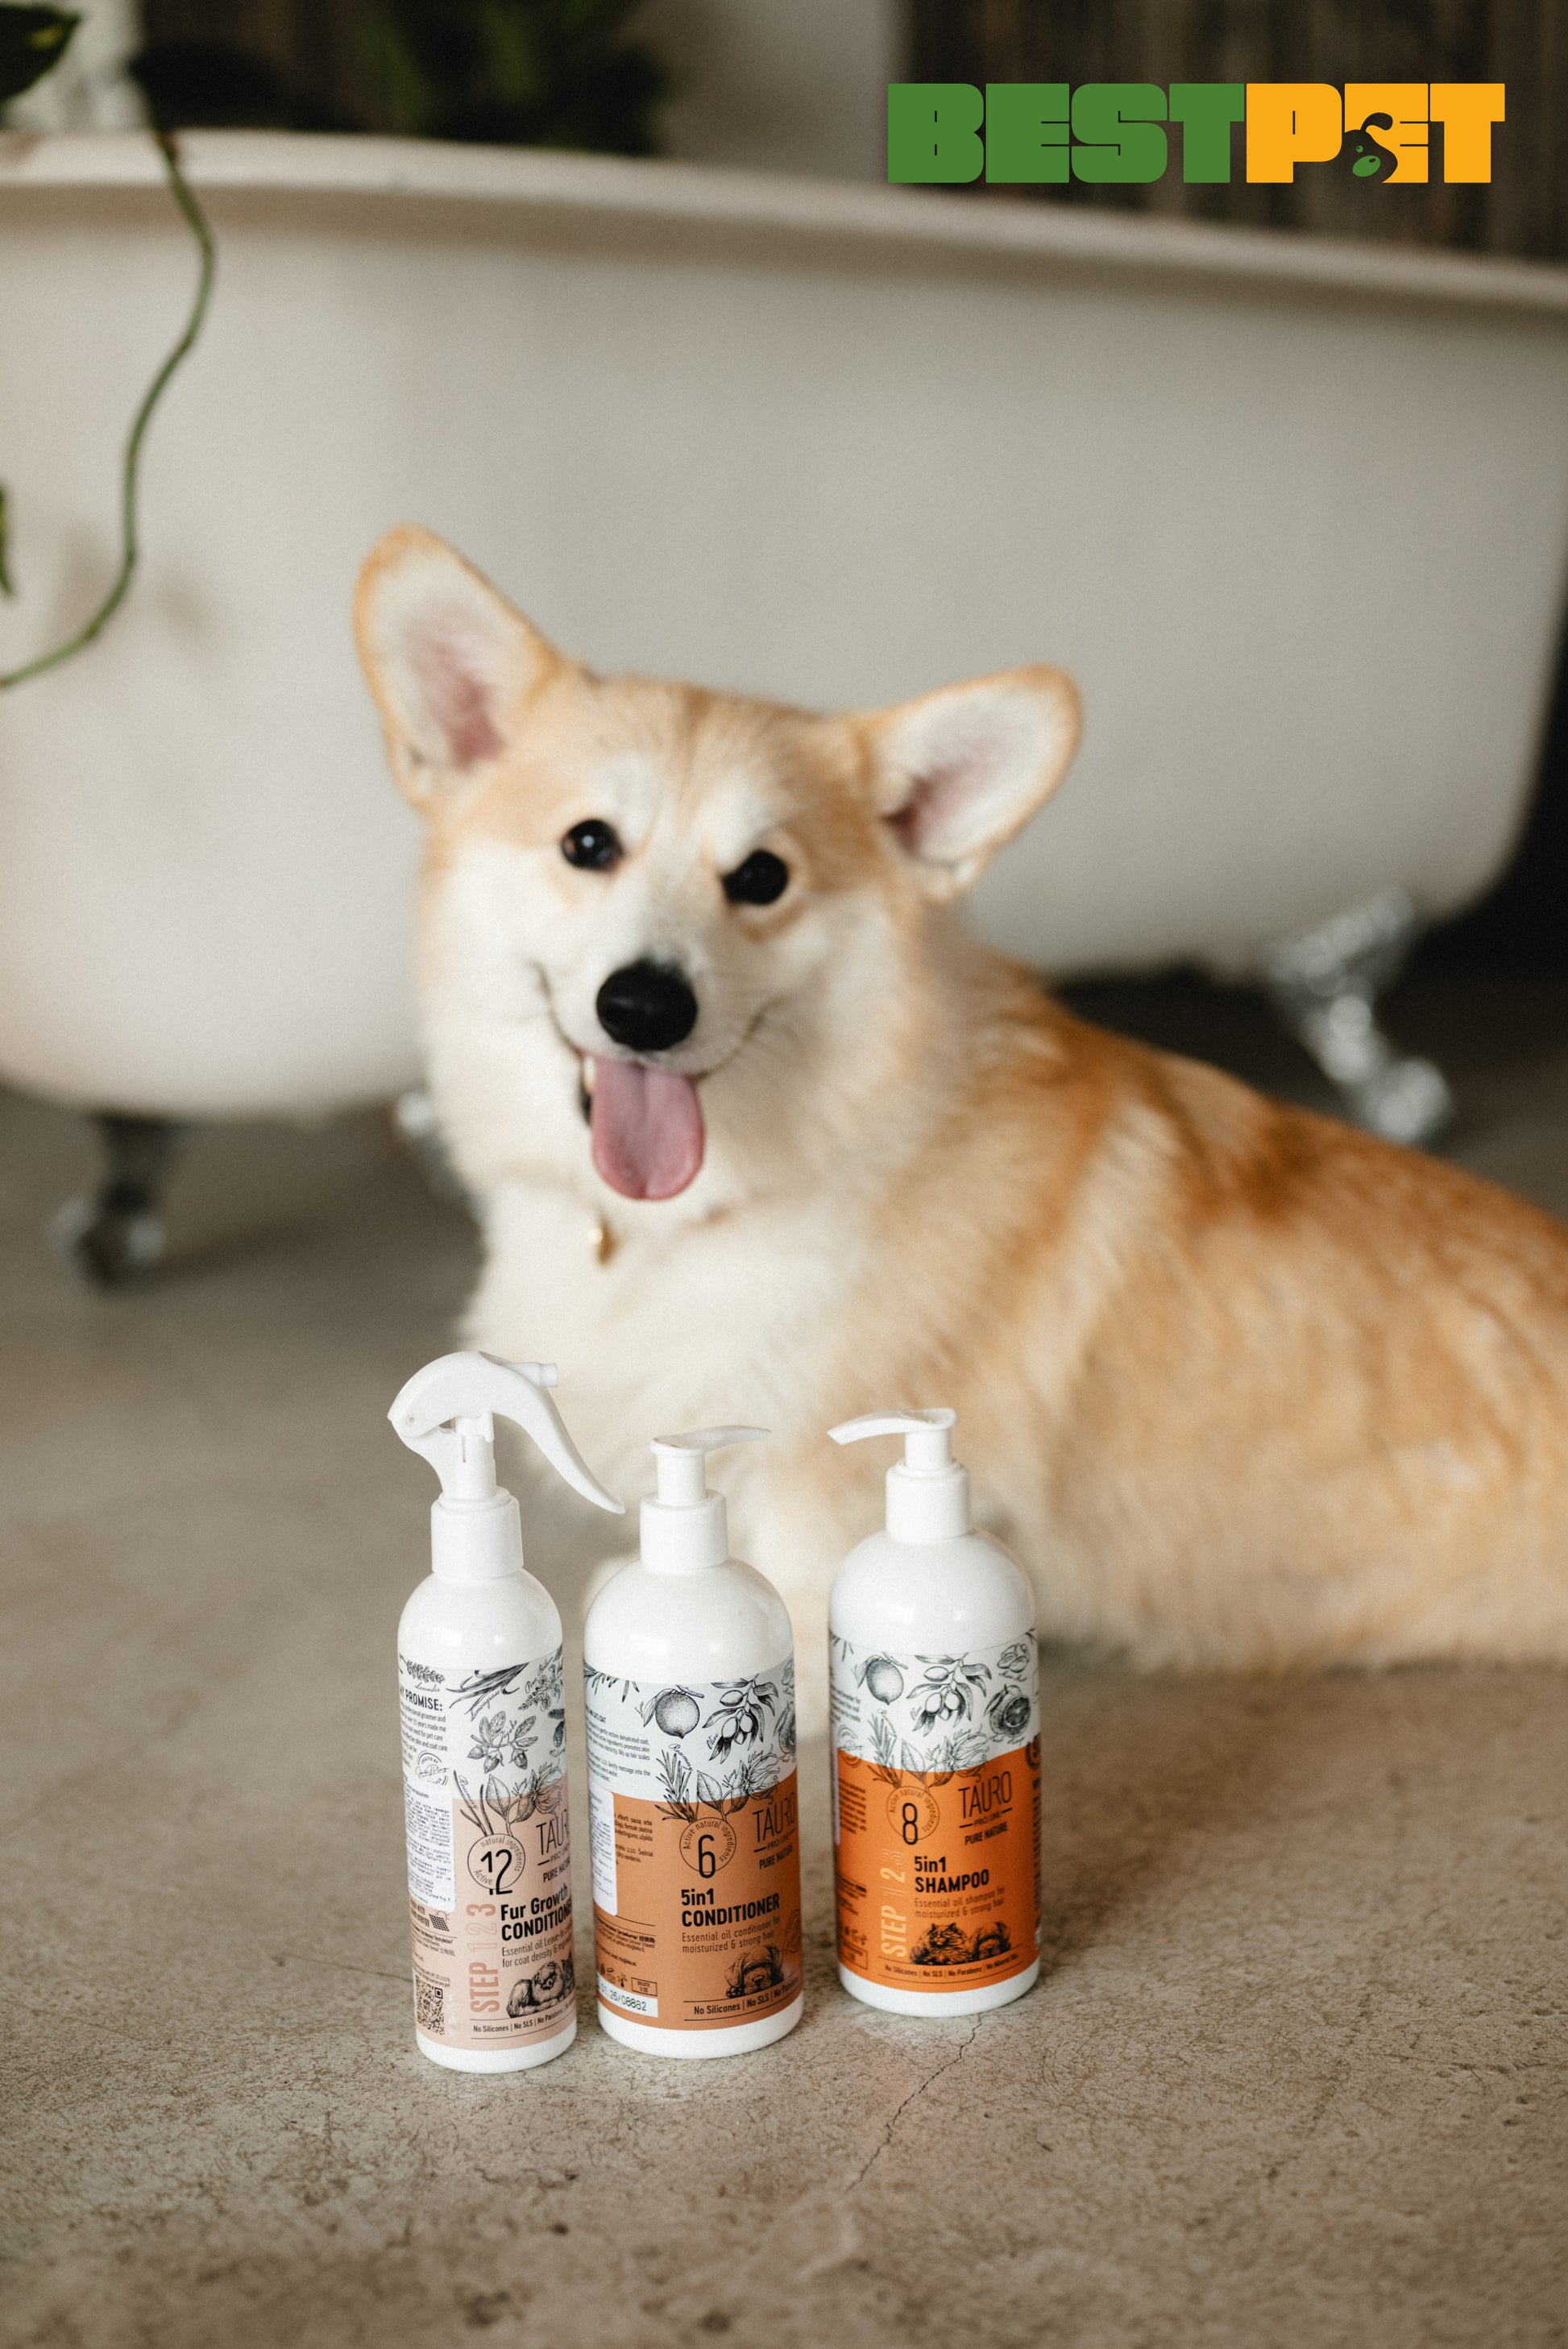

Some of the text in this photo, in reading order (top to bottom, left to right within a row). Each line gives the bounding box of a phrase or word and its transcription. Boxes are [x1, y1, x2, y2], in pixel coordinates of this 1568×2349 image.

[405, 1689, 442, 1712] PROMISE:
[958, 1771, 1012, 1819] TAURO
[753, 1791, 796, 1843] TAURO
[889, 1789, 938, 1833] Active natural ingredients
[902, 1803, 919, 1845] 8
[964, 1821, 1008, 1845] PURE NATURE
[683, 1820, 736, 1863] Active natural ingredients
[474, 1836, 523, 1886] Active natural ingredients
[698, 1834, 716, 1878] 6
[759, 1854, 775, 1870] PURE
[914, 1856, 947, 1873] 5in1
[480, 1849, 513, 1895] 12
[543, 1867, 558, 1882] PURE
[879, 1867, 906, 1884] 2
[915, 1869, 989, 1894] SHAMPOO
[501, 1886, 568, 1921] Fur Growth
[681, 1888, 714, 1906] 5in1
[914, 1897, 951, 1908] Essential
[952, 1896, 964, 1907] oil
[965, 1890, 996, 1905] shampoo
[466, 1903, 496, 1917] 3
[682, 1892, 780, 1928] CONDITIONER
[914, 1907, 960, 1919] moisturized
[682, 1932, 718, 1943] Essential
[721, 1929, 731, 1940] oil
[734, 1919, 771, 1938] conditioner
[880, 1905, 908, 1958] STEP
[502, 1942, 533, 1957] Essential
[682, 1943, 728, 1953] moisturized
[731, 1939, 736, 1949] &
[739, 1935, 761, 1948] strong
[503, 1957, 512, 1968] for
[514, 1956, 529, 1966] coat
[532, 1949, 552, 1962] density
[469, 1961, 500, 2013] STEP
[694, 2006, 705, 2015] No
[707, 2003, 740, 2015] Silicones
[747, 1999, 756, 2008] No
[757, 1994, 769, 2004] SLS
[473, 2025, 482, 2033] No
[523, 2019, 533, 2028] SLS
